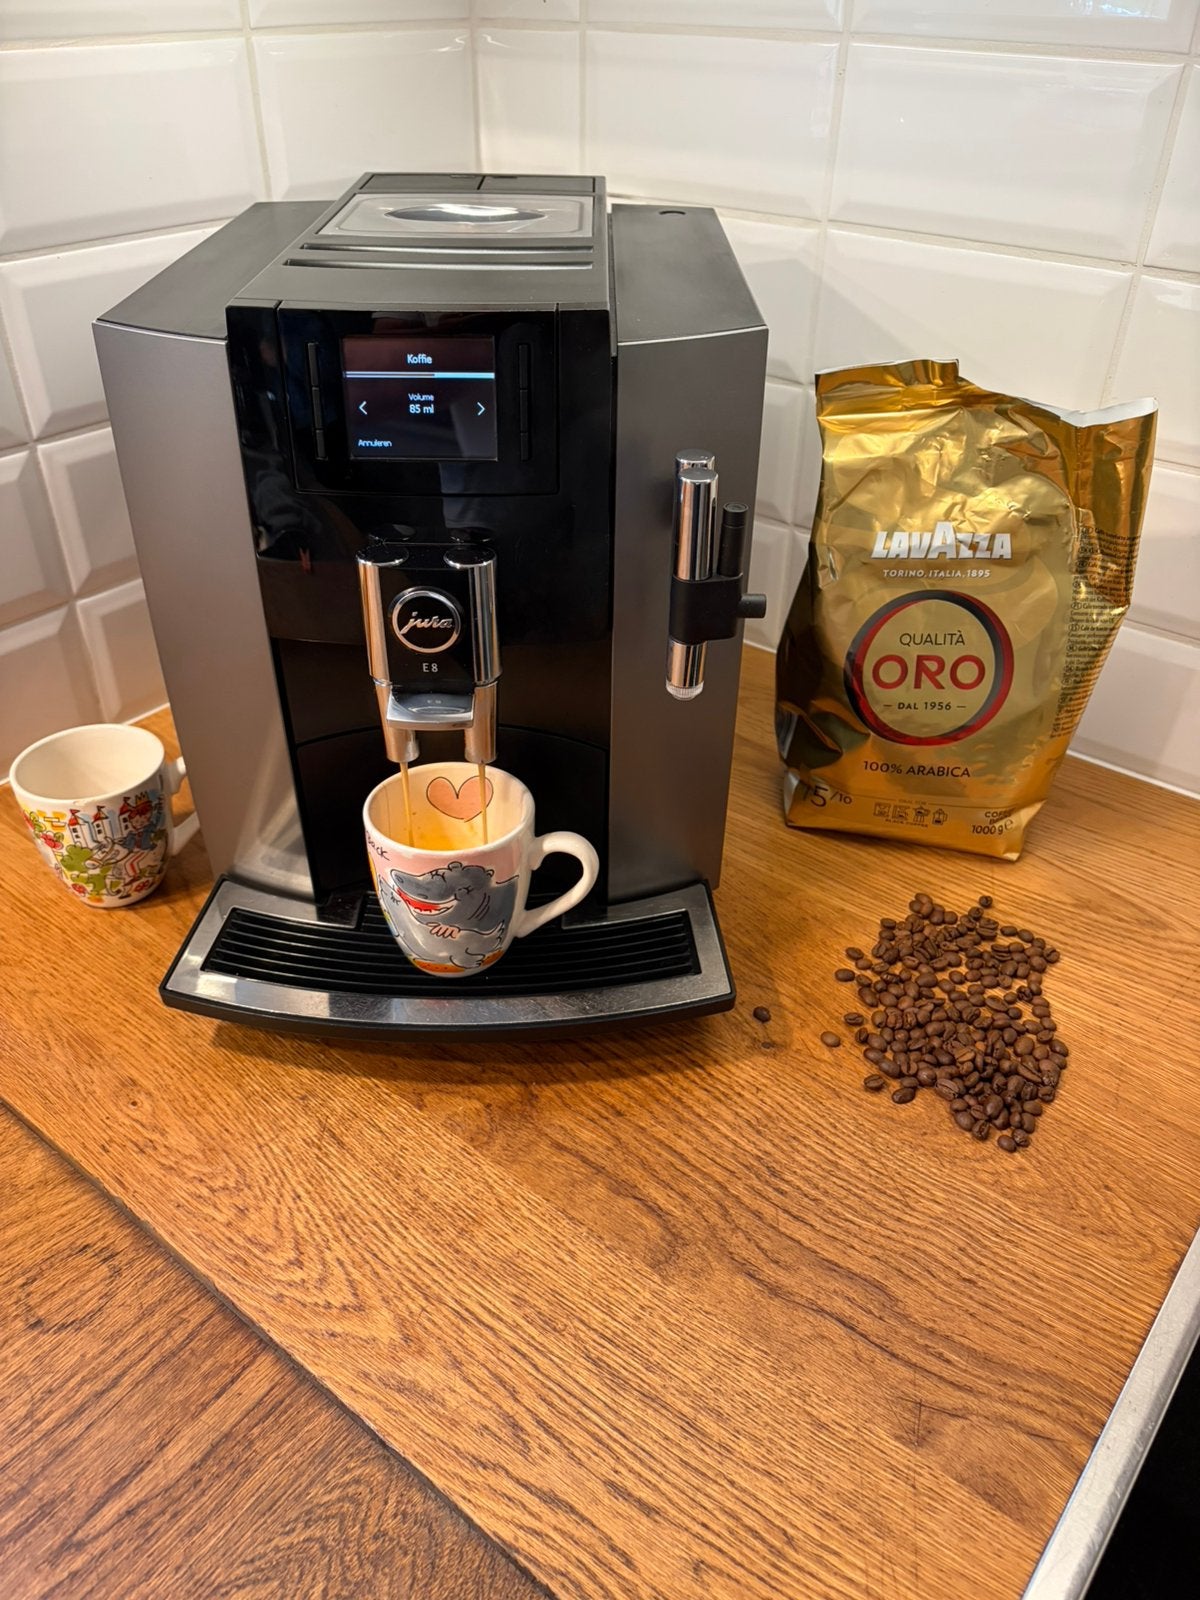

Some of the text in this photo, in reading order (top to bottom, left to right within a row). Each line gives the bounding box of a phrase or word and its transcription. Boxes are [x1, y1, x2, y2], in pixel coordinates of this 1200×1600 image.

[406, 354, 433, 365] Koffie
[408, 393, 434, 401] Volume
[409, 404, 435, 414] 85 ml
[358, 439, 392, 447] Annuleren
[871, 521, 1012, 559] LAVAZZA
[966, 569, 991, 578] 1895
[400, 611, 454, 635] jura
[899, 629, 966, 647] QUALITÀ
[872, 653, 986, 690] ORO
[897, 701, 952, 711] DAL 1956
[863, 760, 971, 778] 100% ARABICA
